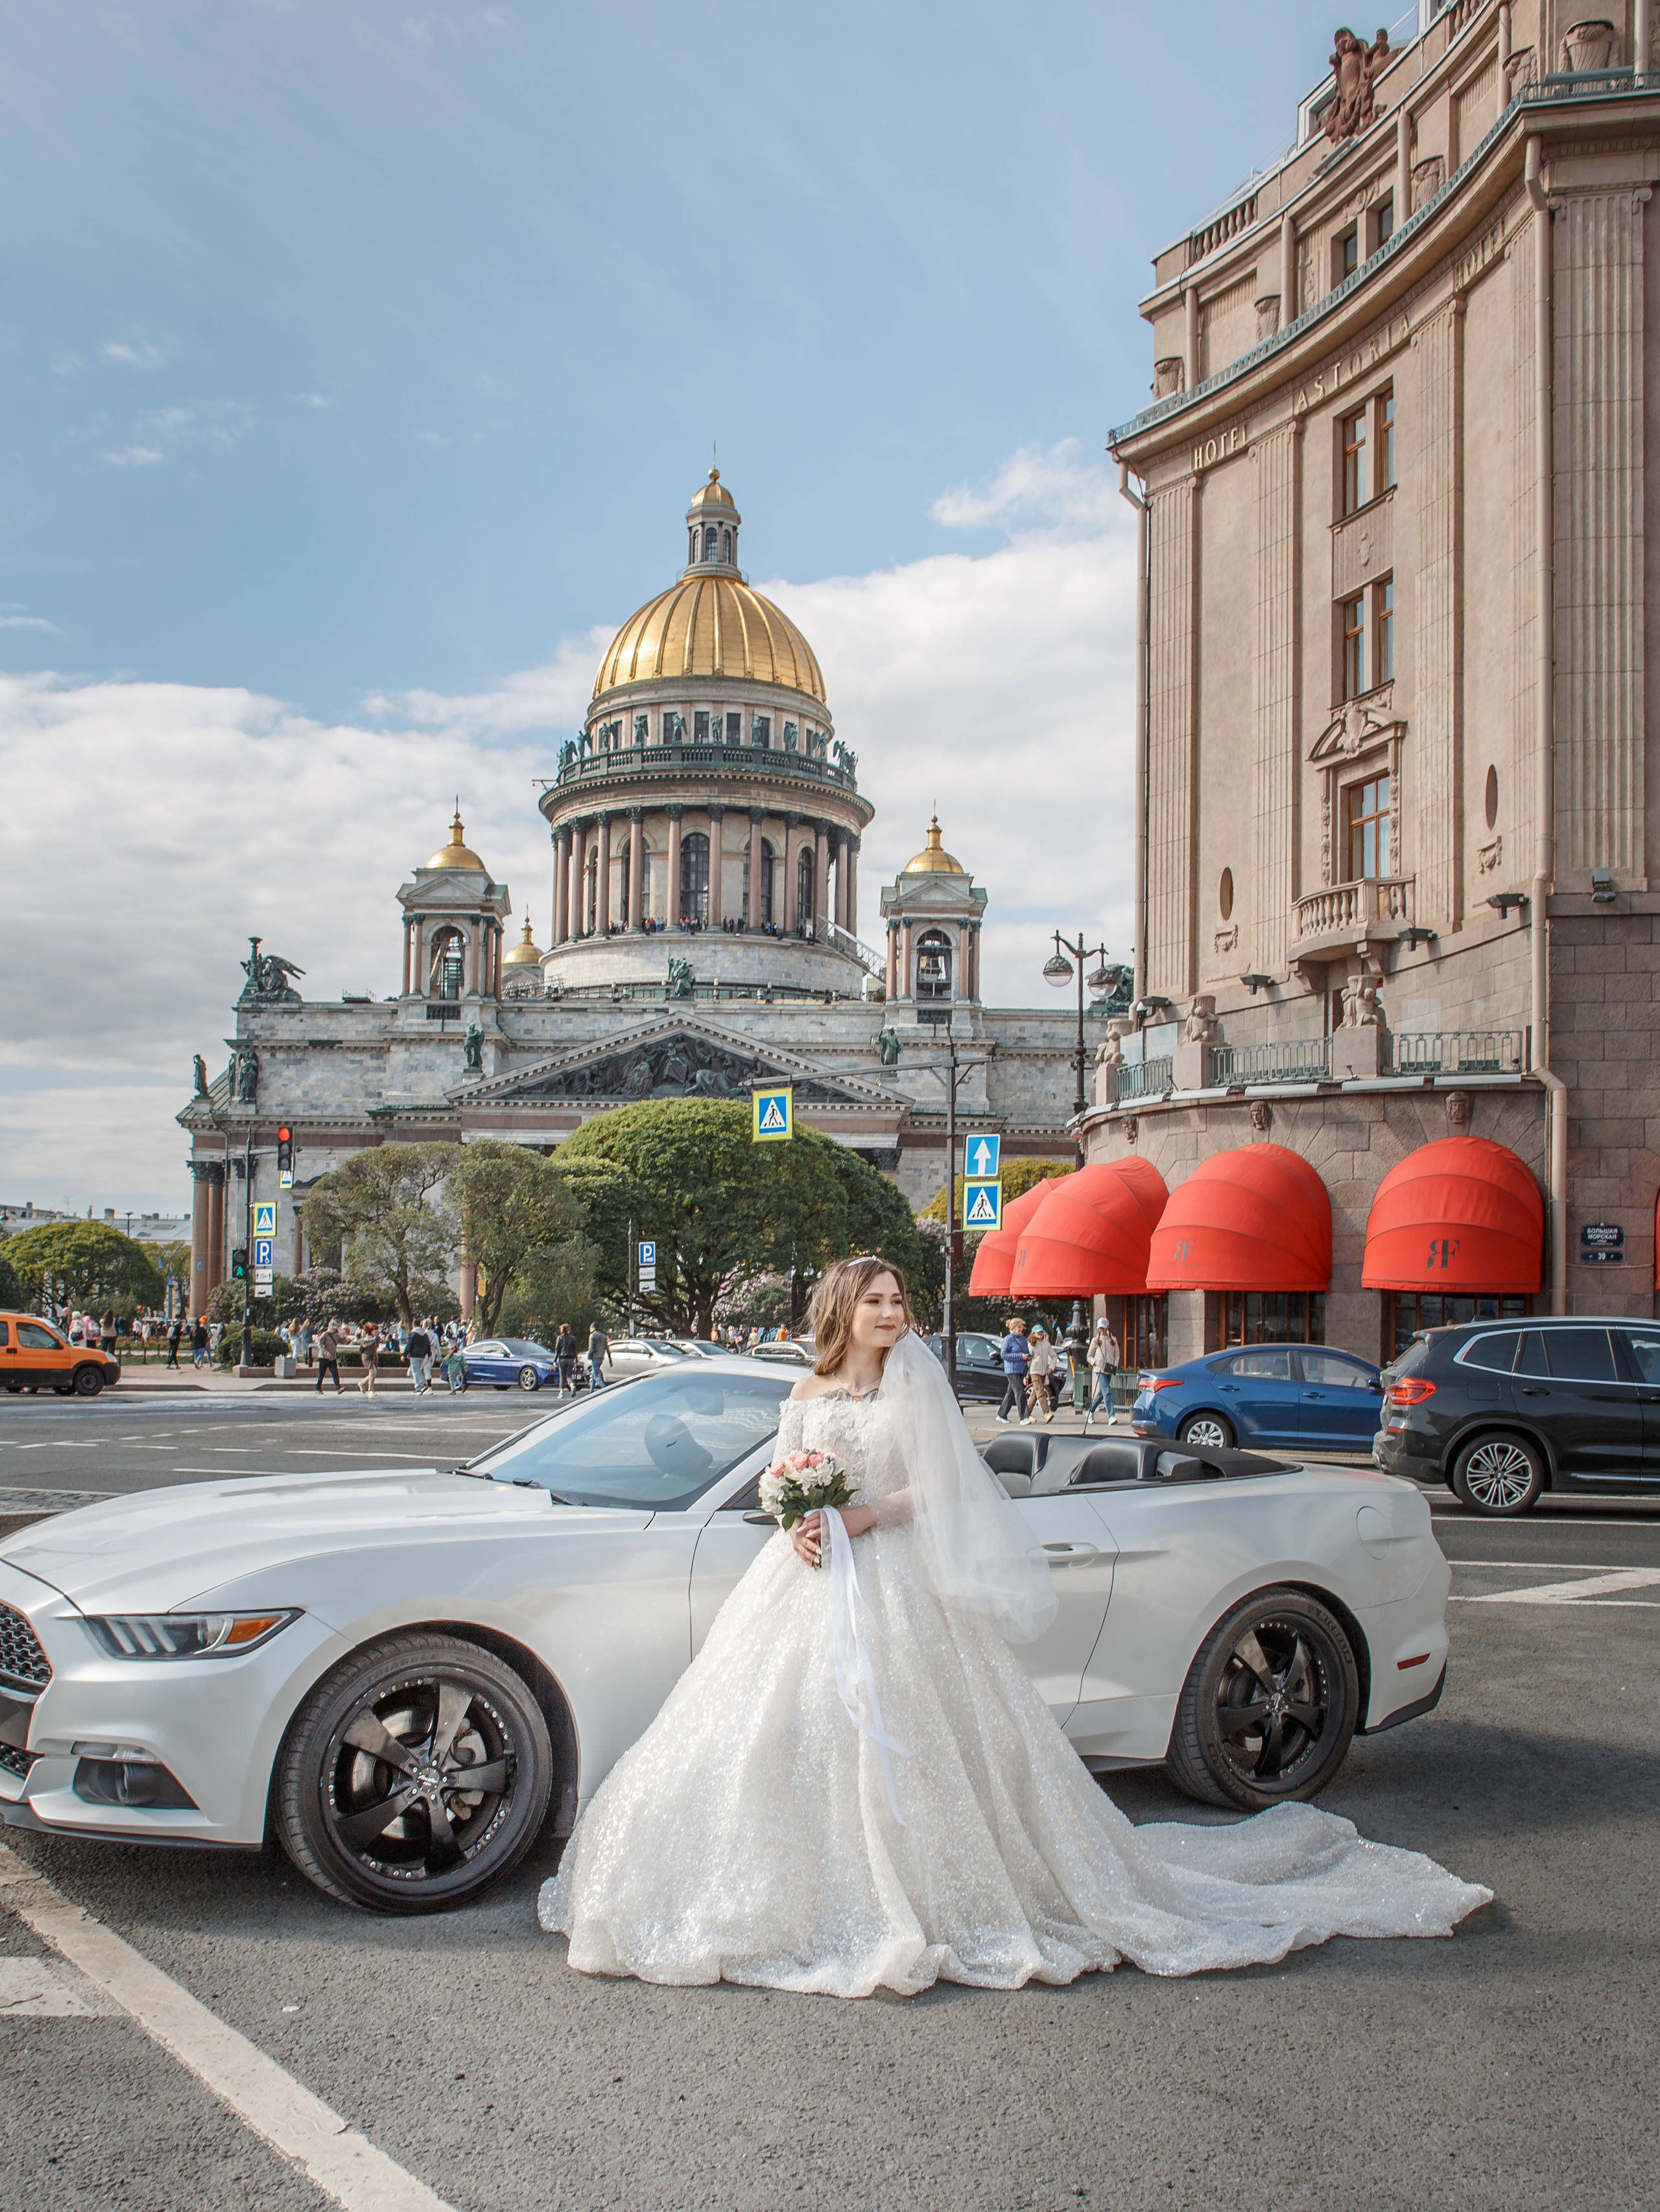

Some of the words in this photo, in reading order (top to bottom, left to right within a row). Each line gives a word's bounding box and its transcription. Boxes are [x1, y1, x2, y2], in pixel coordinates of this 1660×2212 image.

[1194, 423, 1246, 471] HOTEL
[1294, 314, 1409, 416] ASTORIA
[1454, 218, 1504, 292] HOTEL
[1597, 1252, 1606, 1260] 39
[1318, 1611, 1352, 1662] MICHELIN
